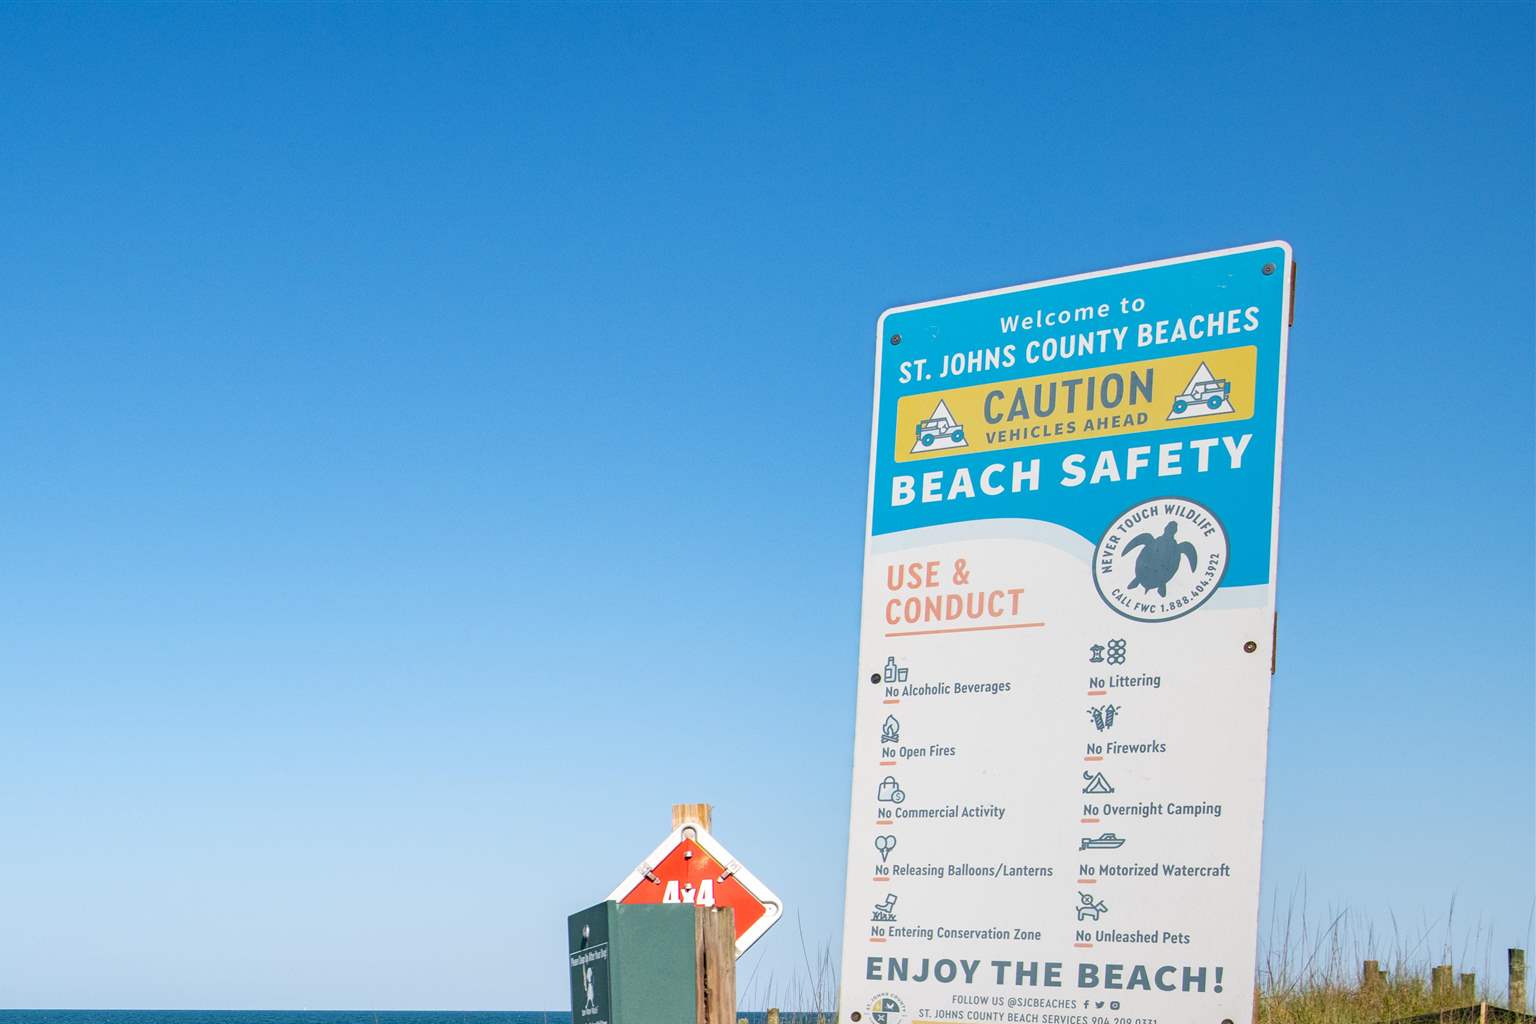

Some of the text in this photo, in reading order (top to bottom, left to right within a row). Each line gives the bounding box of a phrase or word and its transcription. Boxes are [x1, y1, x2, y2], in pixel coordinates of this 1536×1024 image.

[1000, 297, 1146, 334] Welcome to
[898, 306, 1260, 384] ST. JOHNS COUNTY BEACHES
[983, 368, 1154, 424] CAUTION
[985, 411, 1149, 444] VEHICLES AHEAD
[891, 433, 1253, 507] BEACH SAFETY
[1101, 504, 1216, 574] NEVER TOUCH WILDLIFE
[886, 558, 970, 591] USE &
[1111, 553, 1220, 614] CALL FWC 1.888.404.3922
[884, 588, 1025, 626] CONDUCT
[885, 680, 1011, 697] No Alcoholic Beverages
[1089, 673, 1161, 689] No Littering
[882, 744, 956, 760] No Open Fires
[1086, 740, 1167, 755] No Fireworks
[877, 805, 1006, 820] No Commercial Activity
[1083, 802, 1222, 818] No Overnight Camping
[875, 863, 1054, 878] No Releasing Balloons/Lanterns
[1079, 863, 1231, 877] No Motorized Watercraft
[871, 925, 1042, 941] No Entering Conservation Zone
[1075, 930, 1191, 945] No Unleashed Pets
[866, 956, 1224, 993] ENJOY THE BEACH!
[952, 994, 1077, 1009] FOLLOW US @SJCBEACHES
[918, 1008, 932, 1018] ST.
[935, 1009, 964, 1019] JOHNS
[967, 1010, 1005, 1021] COUNTY
[1007, 1012, 1039, 1023] BEACH
[1042, 1014, 1088, 1024] SERVICES
